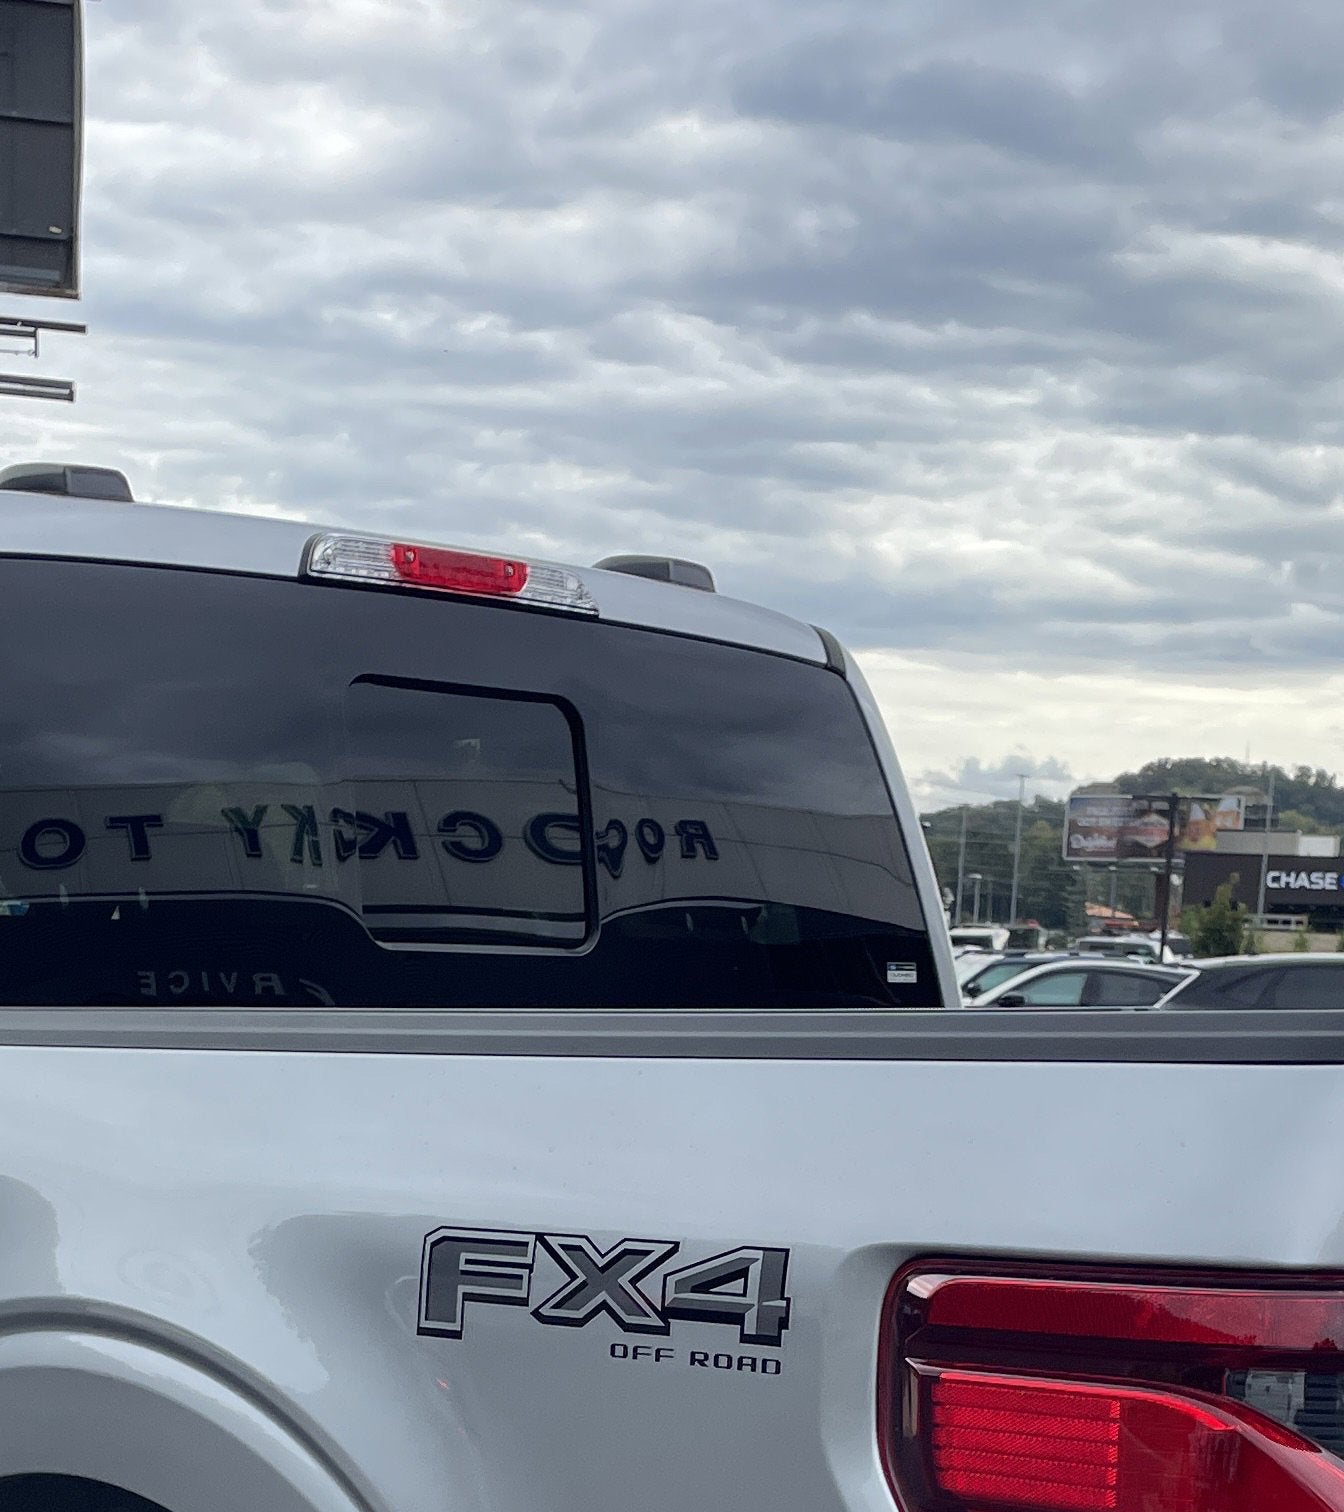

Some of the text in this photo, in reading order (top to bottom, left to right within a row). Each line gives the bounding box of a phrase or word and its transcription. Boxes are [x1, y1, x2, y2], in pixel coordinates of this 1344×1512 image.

[1266, 871, 1338, 890] CHASE
[416, 1226, 792, 1347] FX4
[610, 1343, 782, 1375] OFF ROAD
